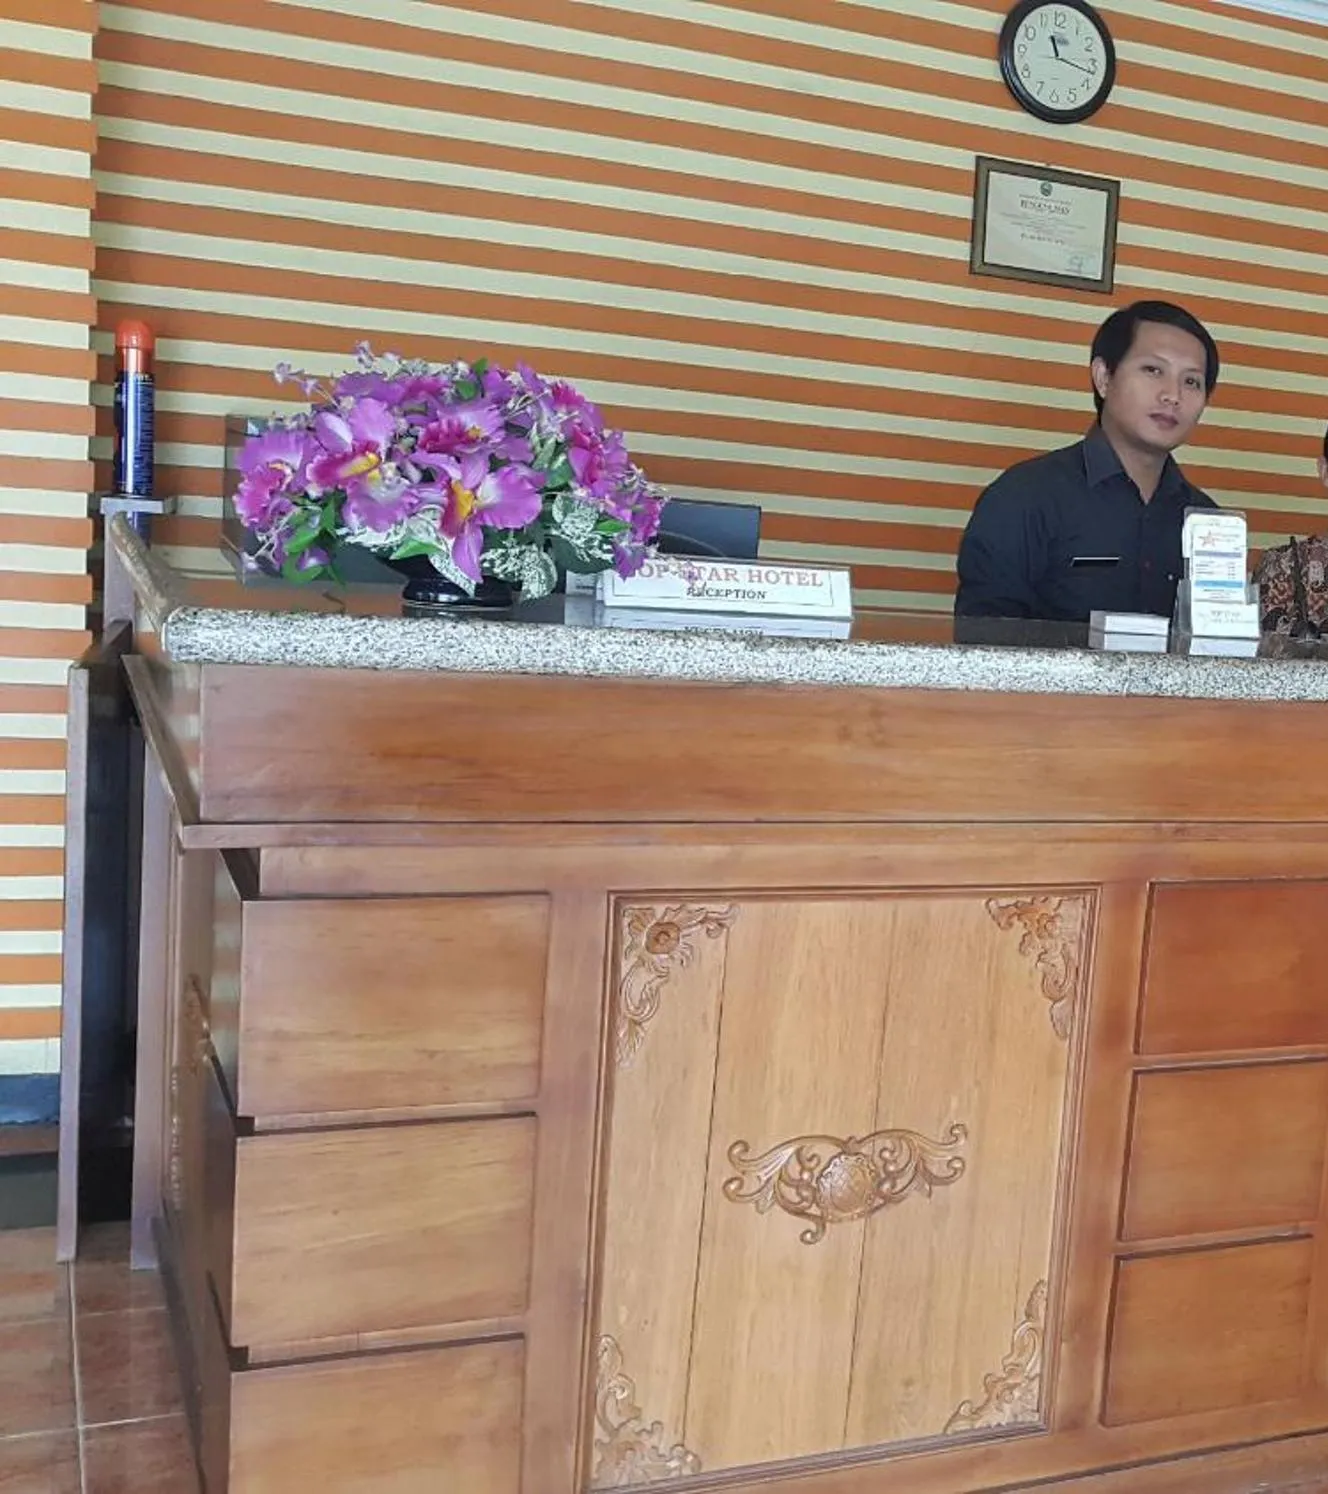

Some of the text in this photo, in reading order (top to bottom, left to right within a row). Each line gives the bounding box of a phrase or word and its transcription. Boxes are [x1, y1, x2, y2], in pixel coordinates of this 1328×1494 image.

[1040, 13, 1047, 28] 11
[1054, 10, 1066, 29] 12
[1025, 23, 1036, 41] 10
[1017, 43, 1027, 58] 9
[1084, 36, 1093, 53] 2
[1021, 63, 1031, 79] 8
[1087, 58, 1098, 75] 3
[1036, 80, 1045, 96] 7
[1080, 78, 1090, 91] 4
[1049, 89, 1059, 104] 6
[1067, 88, 1077, 103] 5
[747, 569, 824, 588] HOTEL
[686, 585, 768, 599] RECEPTION
